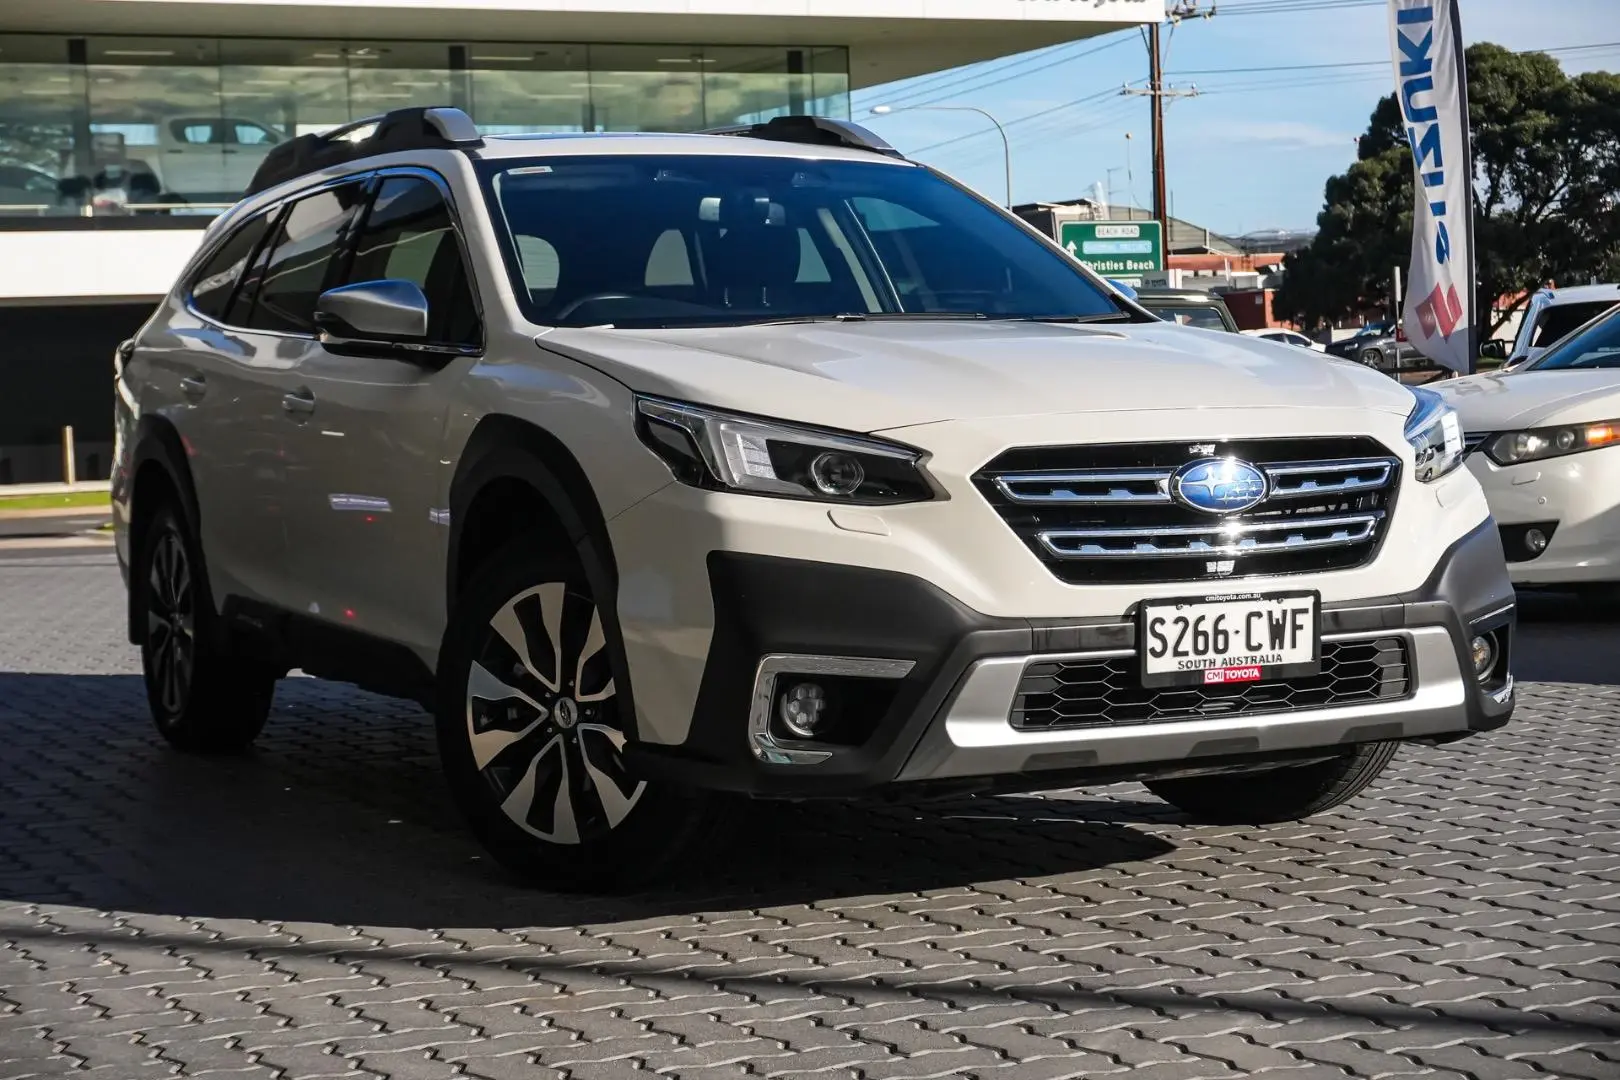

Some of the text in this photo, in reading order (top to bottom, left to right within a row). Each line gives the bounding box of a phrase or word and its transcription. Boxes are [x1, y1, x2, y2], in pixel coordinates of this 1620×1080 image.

[1121, 227, 1138, 236] ROAD
[1126, 260, 1154, 270] Beach
[1205, 592, 1261, 602] cmitoyota.com.au
[1178, 653, 1283, 670] SOUTH AUSTRALIA
[1206, 668, 1260, 681] CMI TOYOTA
